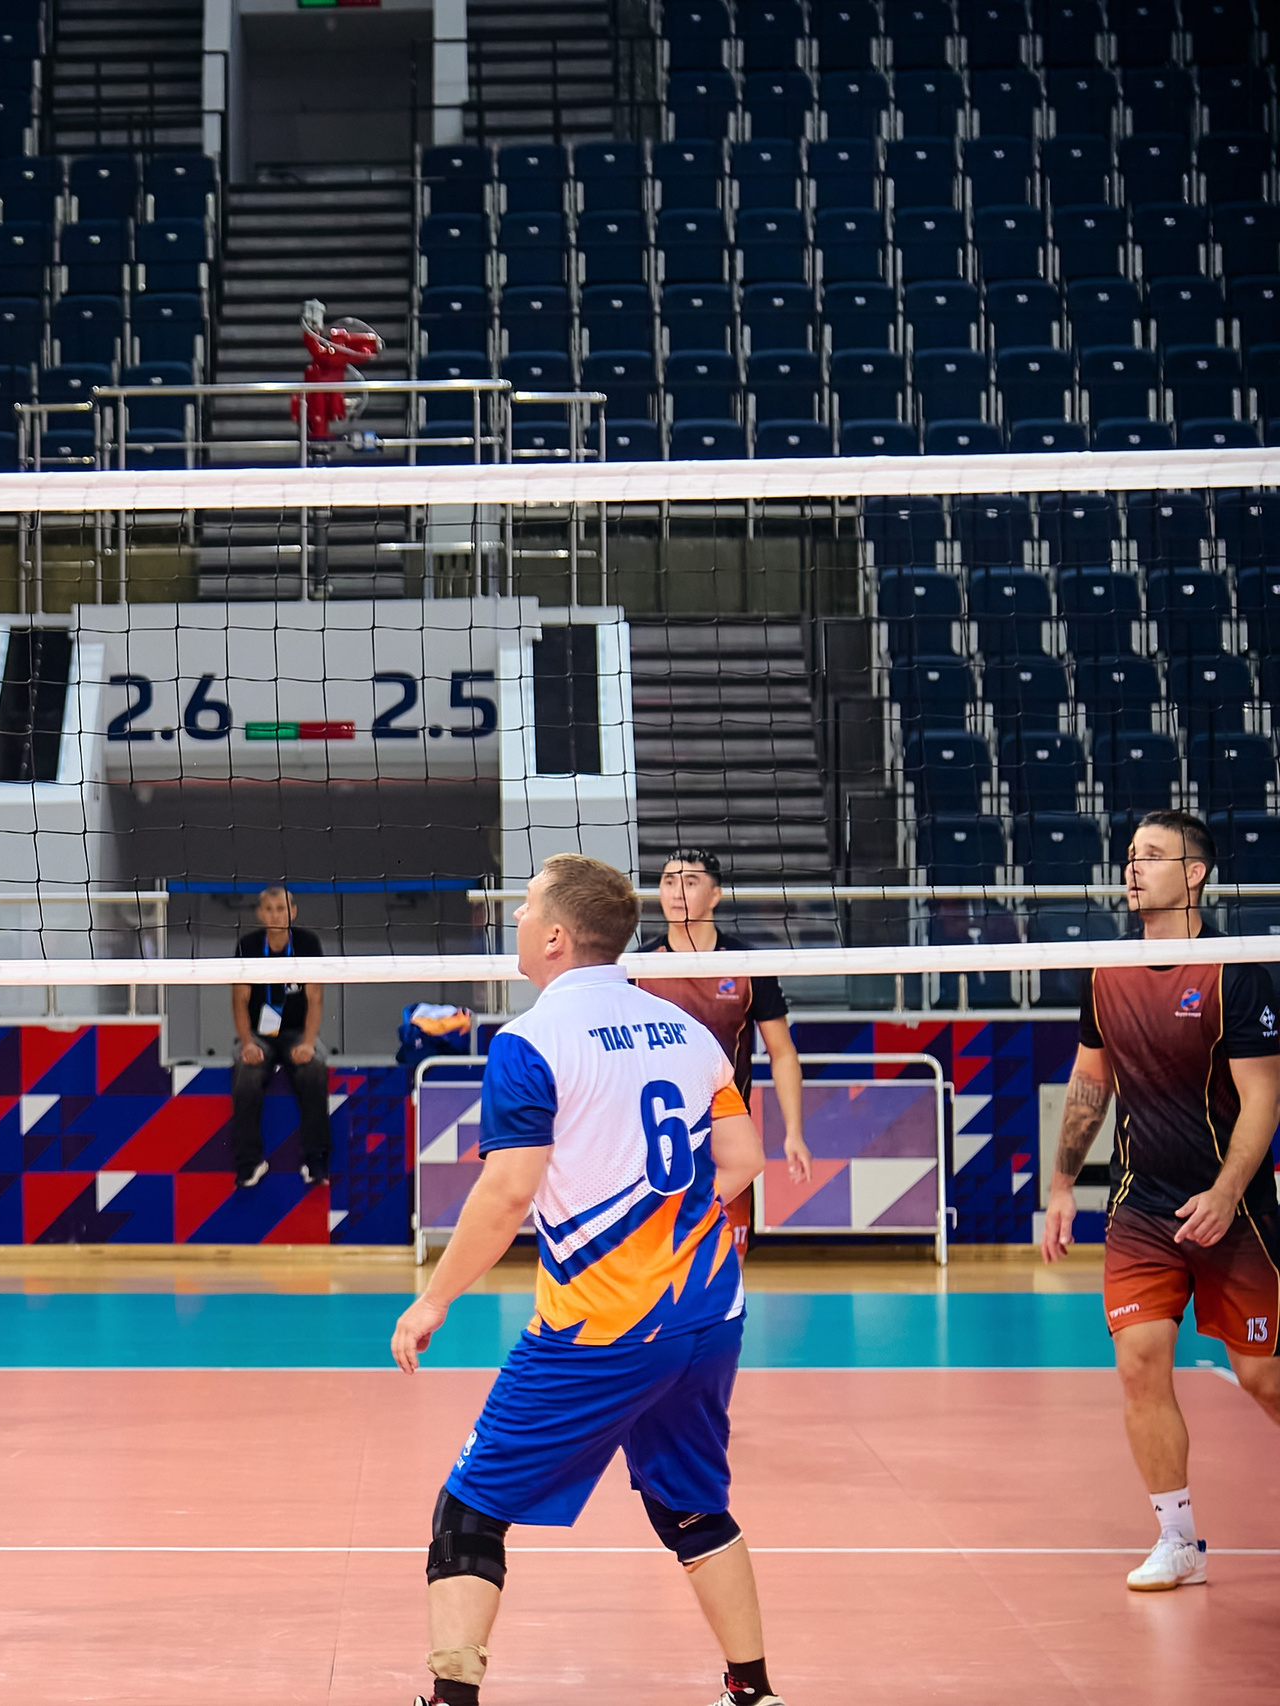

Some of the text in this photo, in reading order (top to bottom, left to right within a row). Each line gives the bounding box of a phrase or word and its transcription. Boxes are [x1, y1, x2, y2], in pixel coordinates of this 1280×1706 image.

[108, 673, 233, 741] 2.6
[372, 670, 498, 739] 2.5
[640, 1079, 696, 1196] 6
[733, 1225, 748, 1245] 17
[1245, 1317, 1268, 1342] 13
